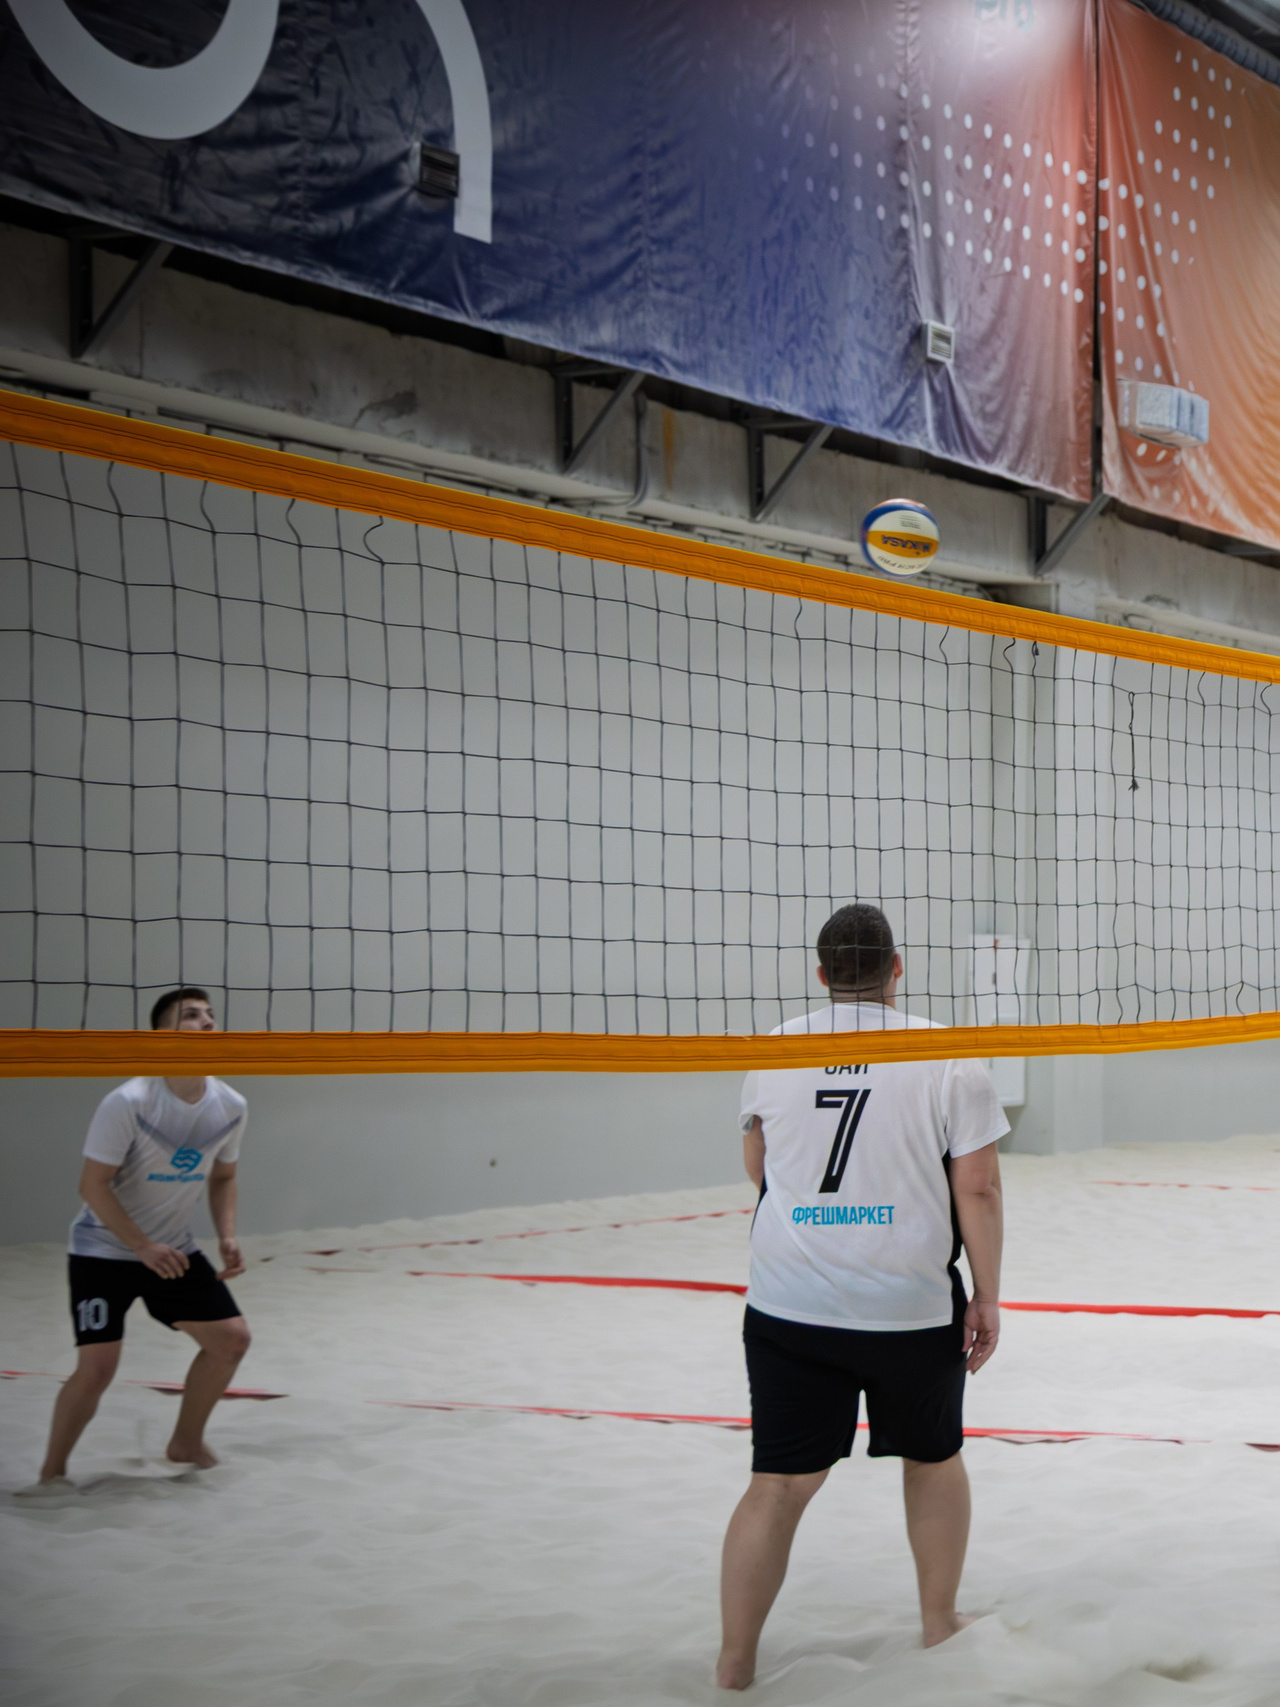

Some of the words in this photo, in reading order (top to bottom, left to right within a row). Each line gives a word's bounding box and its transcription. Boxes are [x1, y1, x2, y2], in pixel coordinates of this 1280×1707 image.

[815, 1089, 872, 1193] 7
[792, 1205, 895, 1226] ФРЕШМАРКЕТ
[76, 1297, 109, 1331] 10
